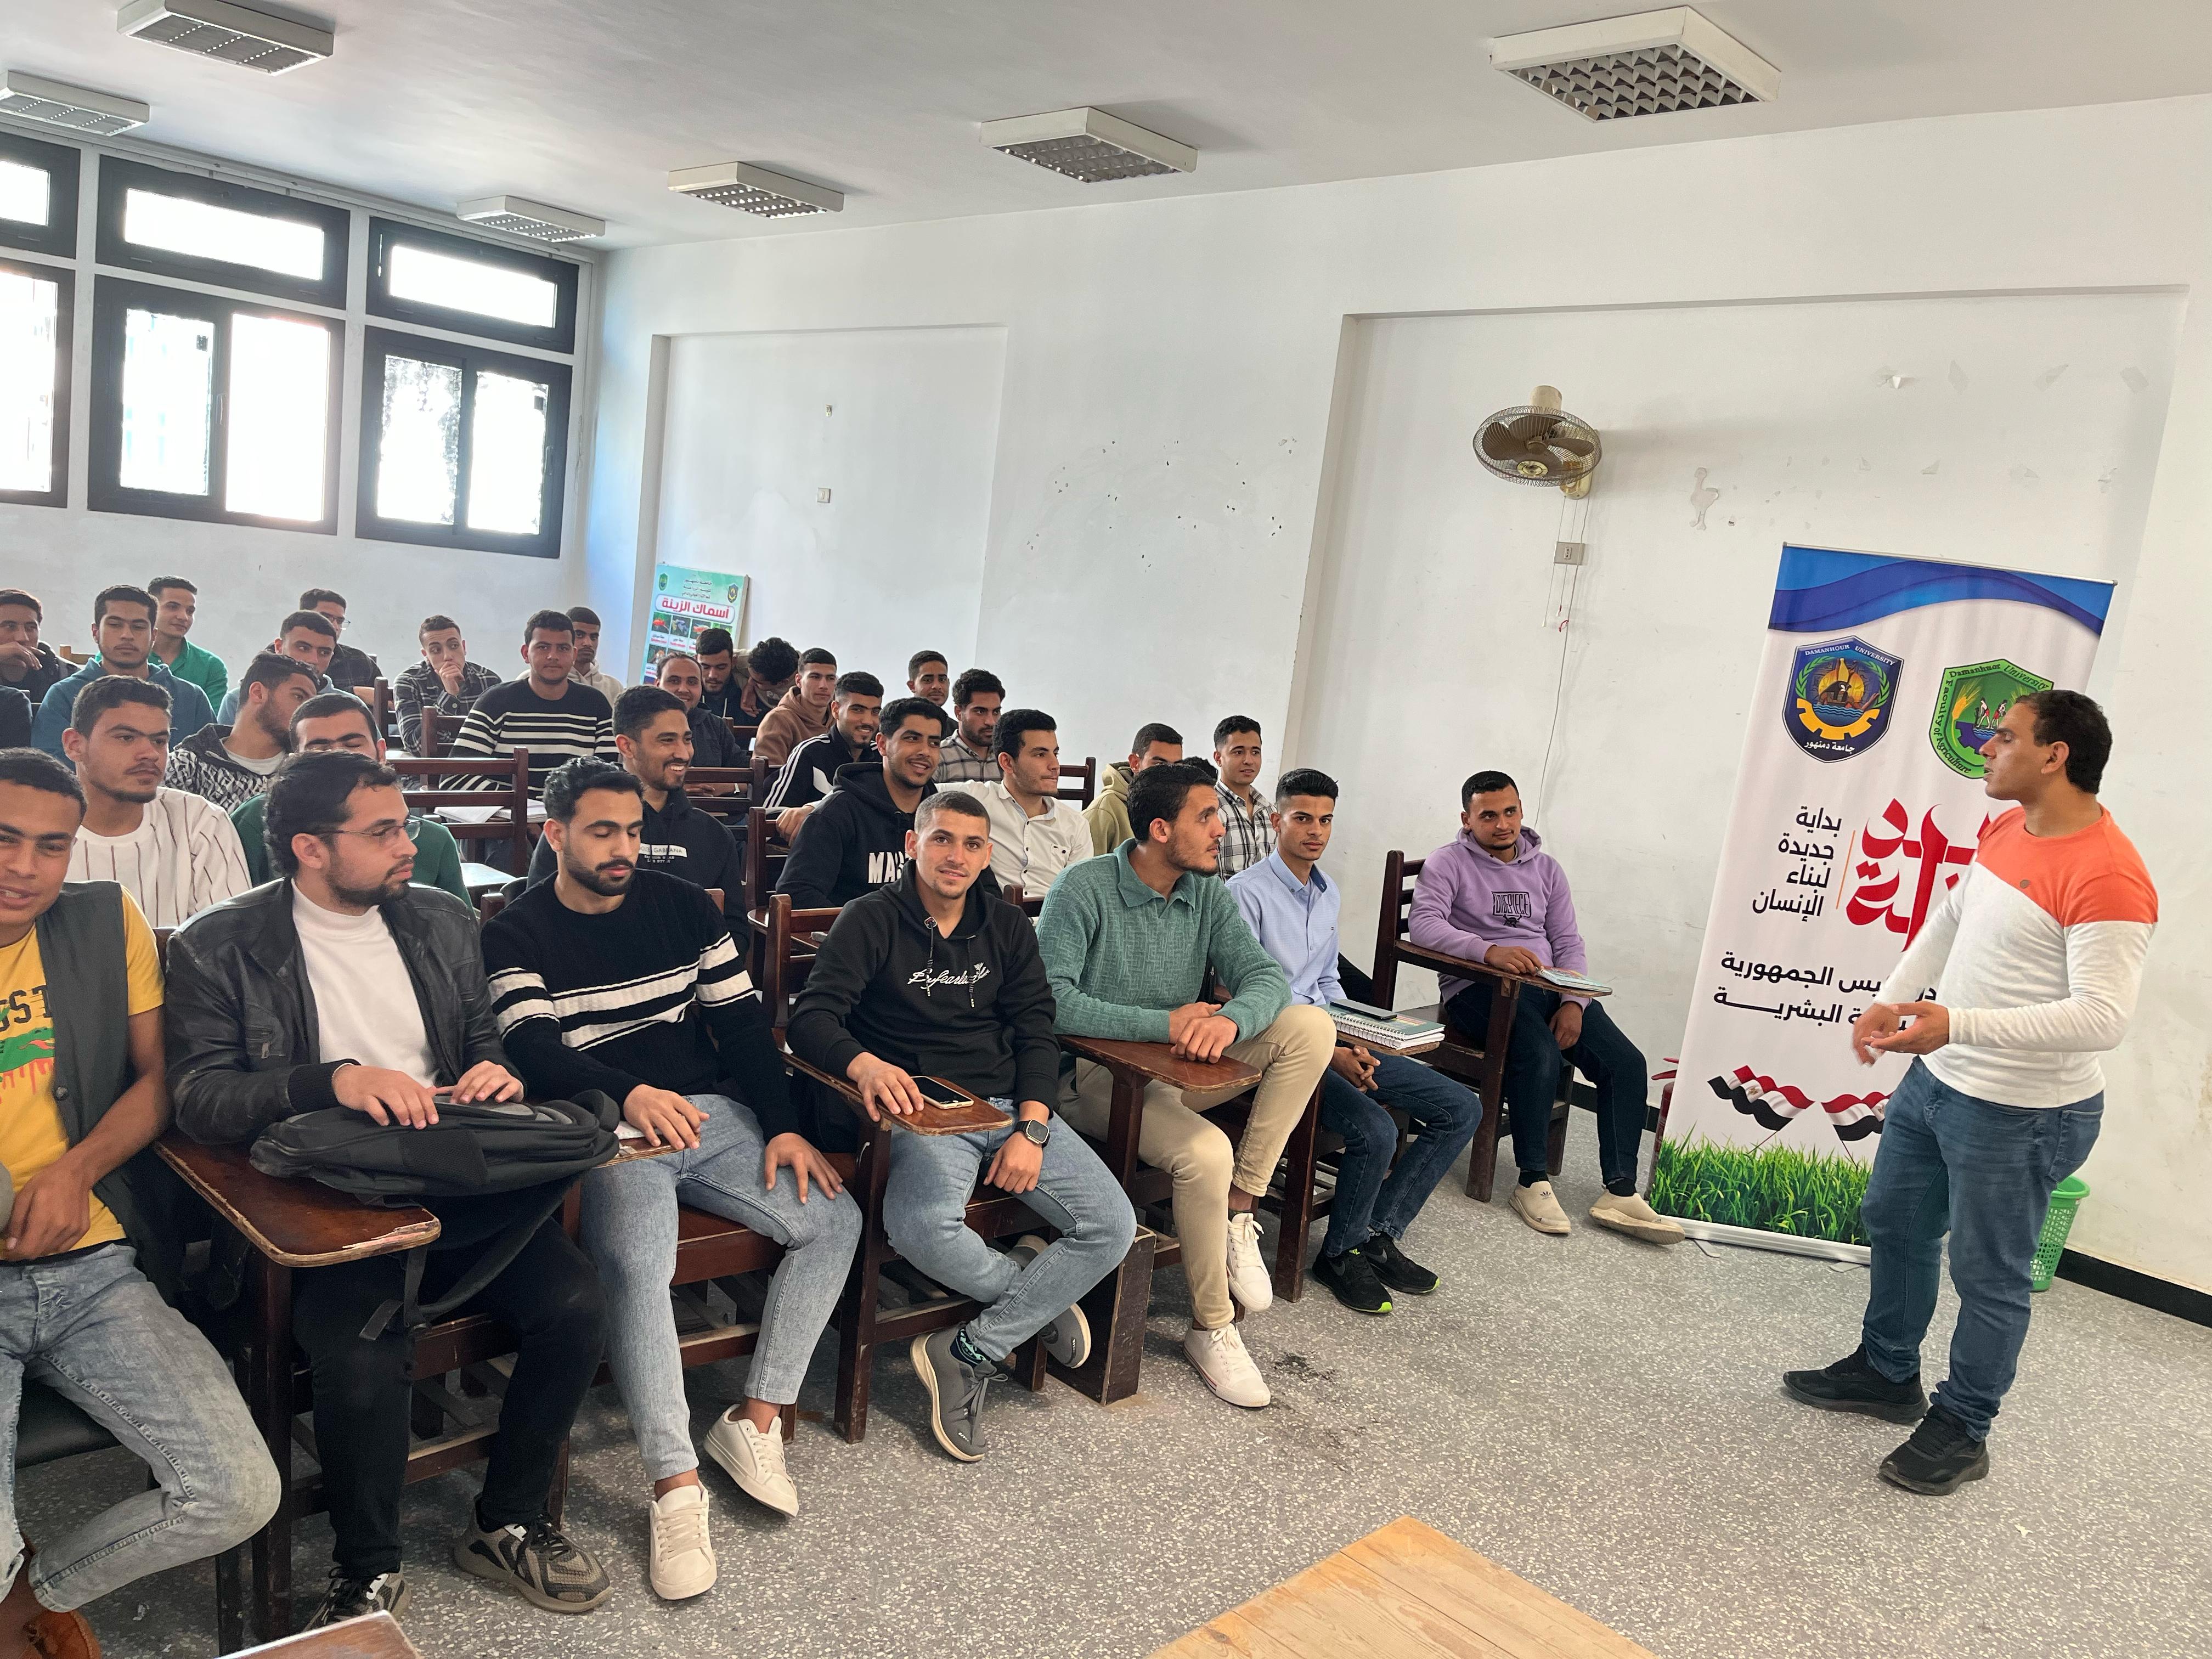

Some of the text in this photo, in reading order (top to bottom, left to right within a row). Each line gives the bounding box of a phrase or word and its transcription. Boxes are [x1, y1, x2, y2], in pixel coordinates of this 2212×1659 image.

[662, 597, 730, 619] أسماك الزينة
[1805, 644, 1895, 665] DAMANHOUR UNIVERSITY
[2004, 665, 2049, 690] University
[1933, 679, 1972, 774] Faculty of Agriculture
[1804, 741, 1855, 754] جامعة دمنهور
[1796, 806, 1842, 838] بداية
[1778, 832, 1834, 866] جديدة
[1786, 864, 1831, 893] لبناء
[1752, 889, 1824, 922] الإنسان
[1720, 951, 1834, 989] الجمهورية
